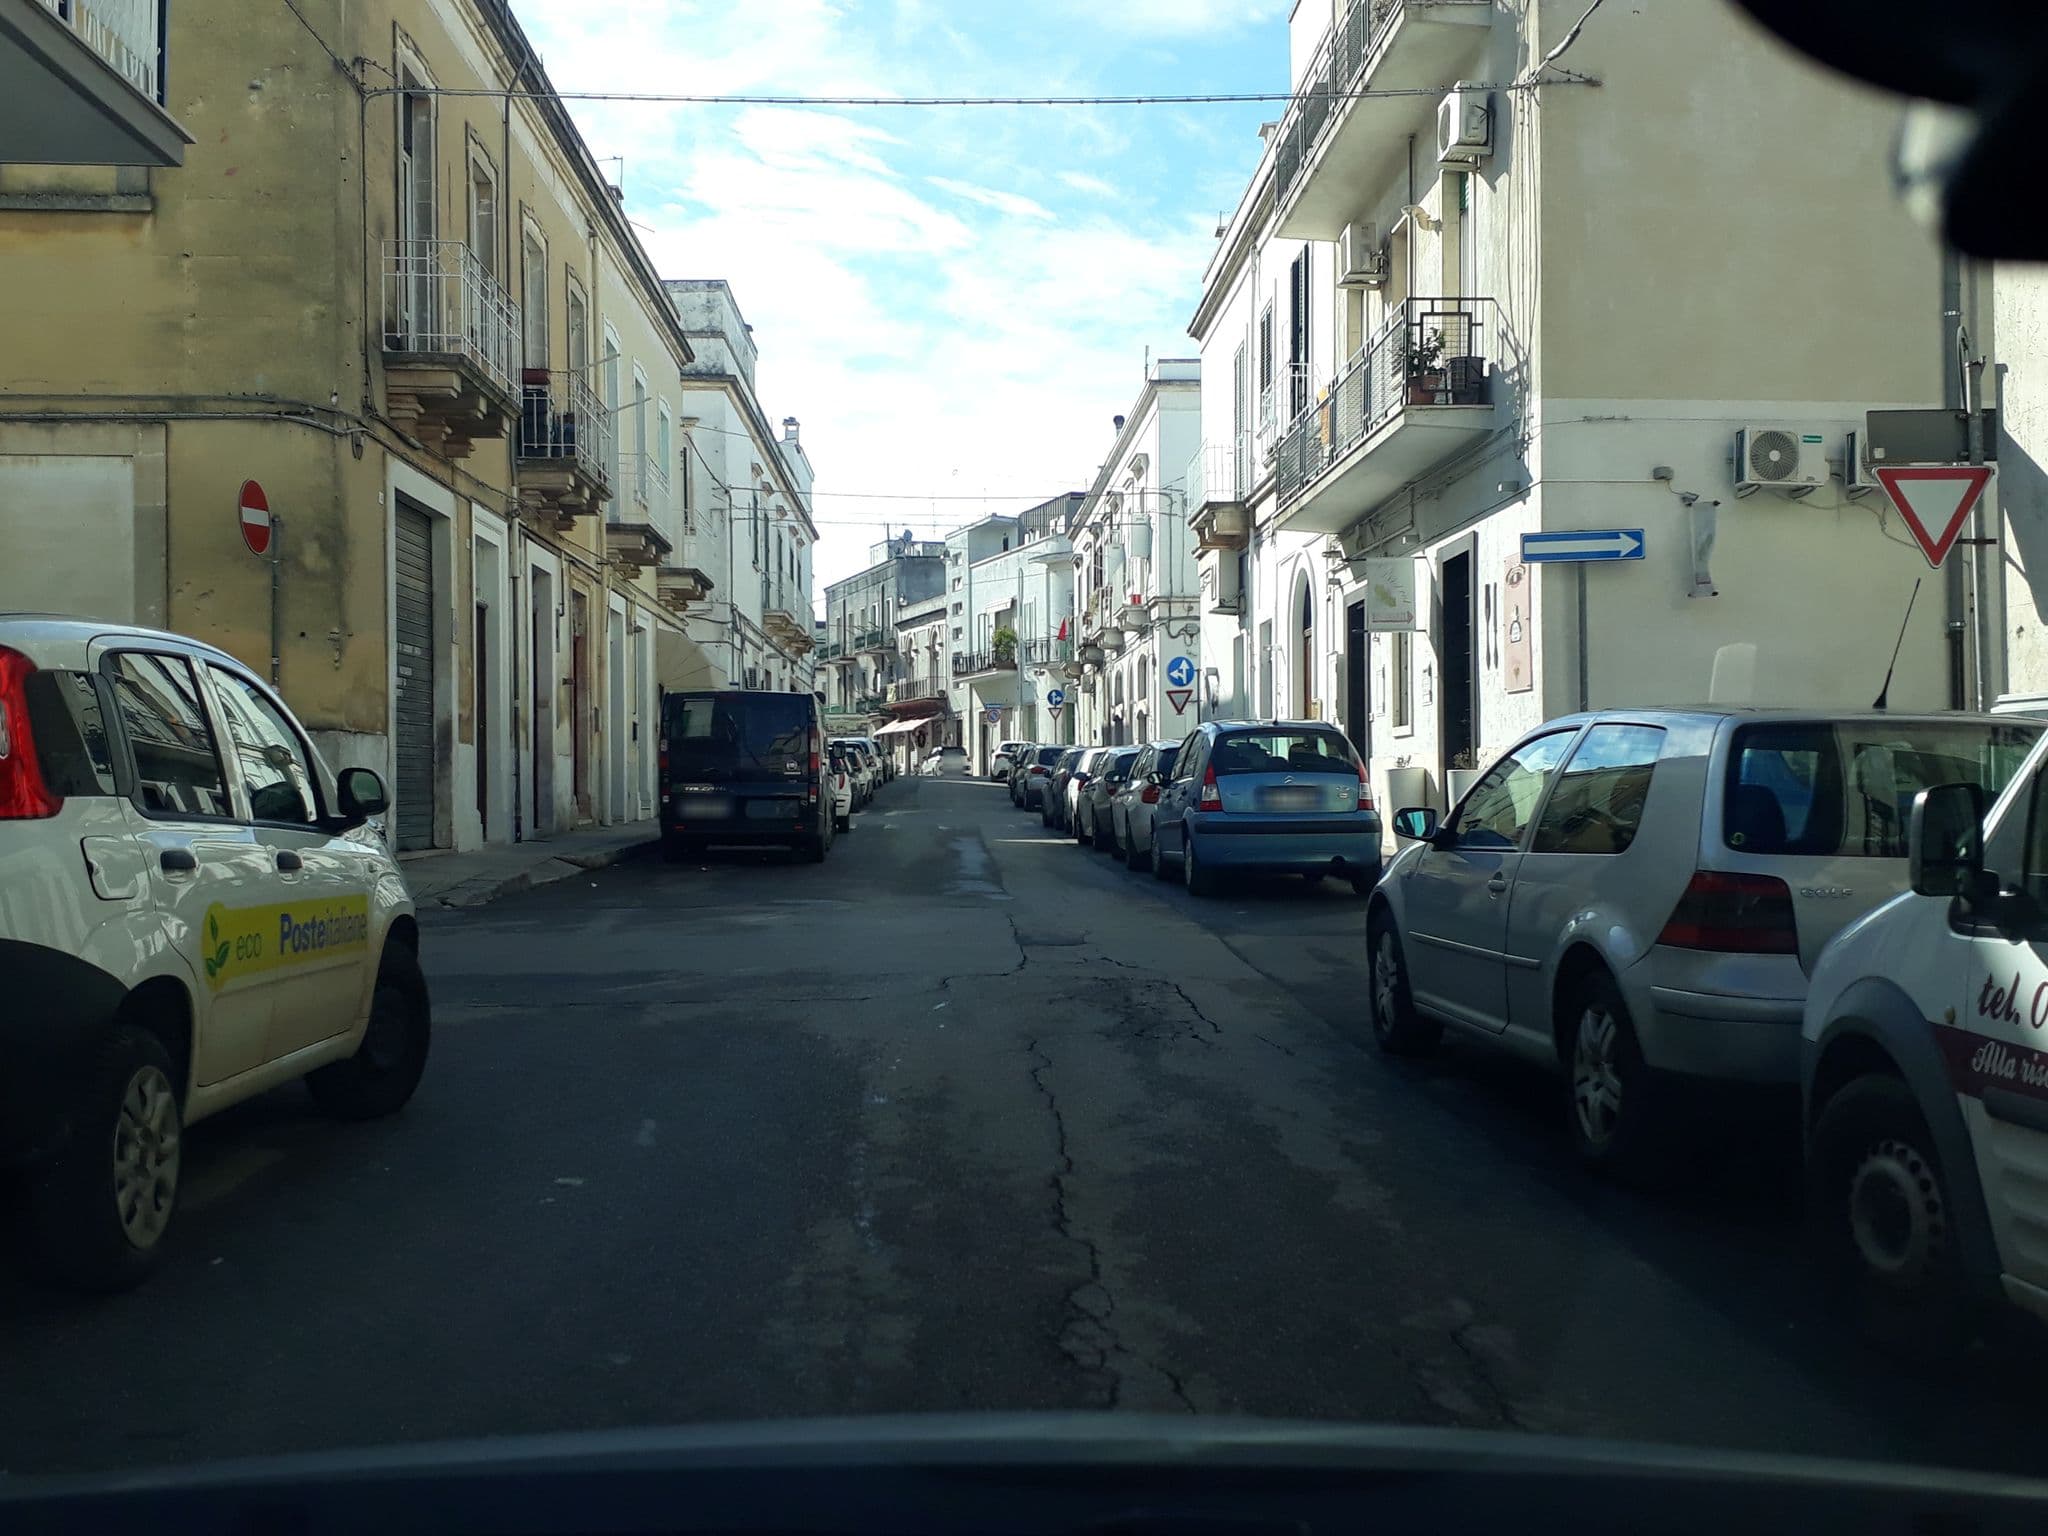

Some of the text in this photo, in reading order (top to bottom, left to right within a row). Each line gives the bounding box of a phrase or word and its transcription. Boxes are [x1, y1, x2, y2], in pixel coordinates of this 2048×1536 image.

[236, 933, 262, 961] eco
[1978, 971, 2020, 1025] tel.
[1972, 1041, 2016, 1079] Alla
